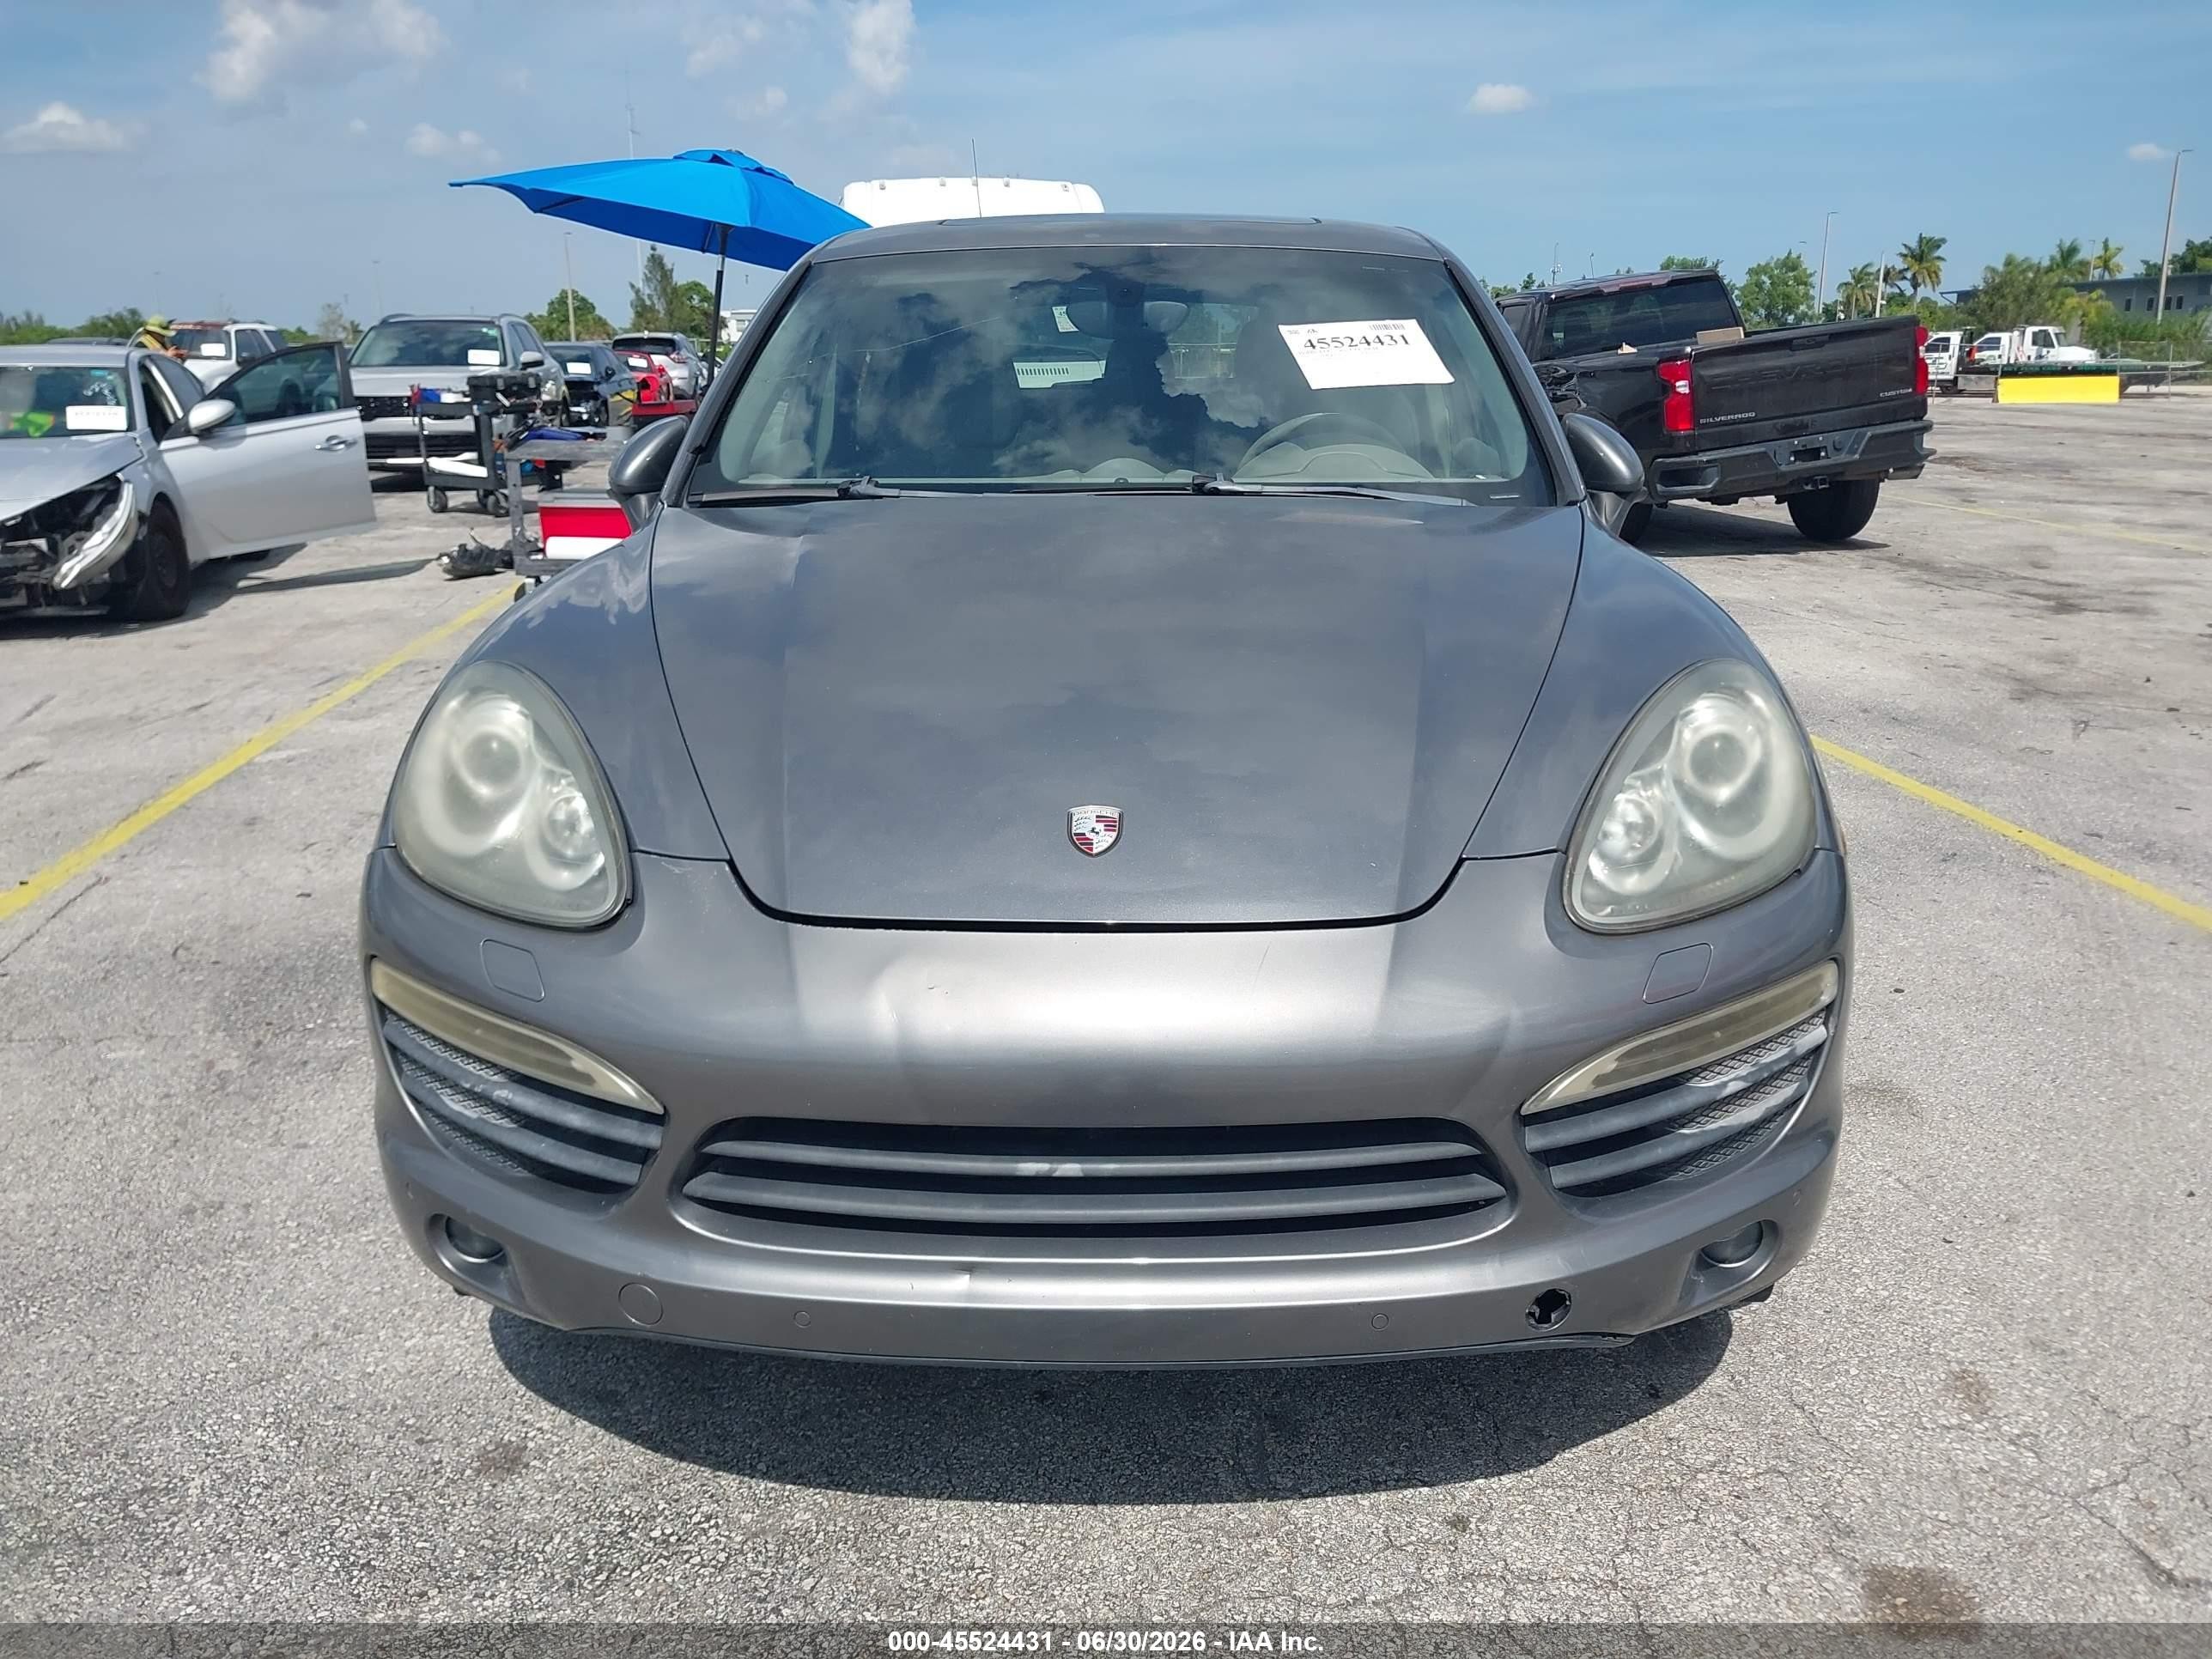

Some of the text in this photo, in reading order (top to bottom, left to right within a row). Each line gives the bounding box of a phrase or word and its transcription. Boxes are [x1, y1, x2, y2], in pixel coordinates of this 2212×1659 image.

[1303, 332, 1411, 350] 45524431
[1879, 387, 1913, 398] CUSTOM
[1699, 411, 1756, 424] SILVERADO
